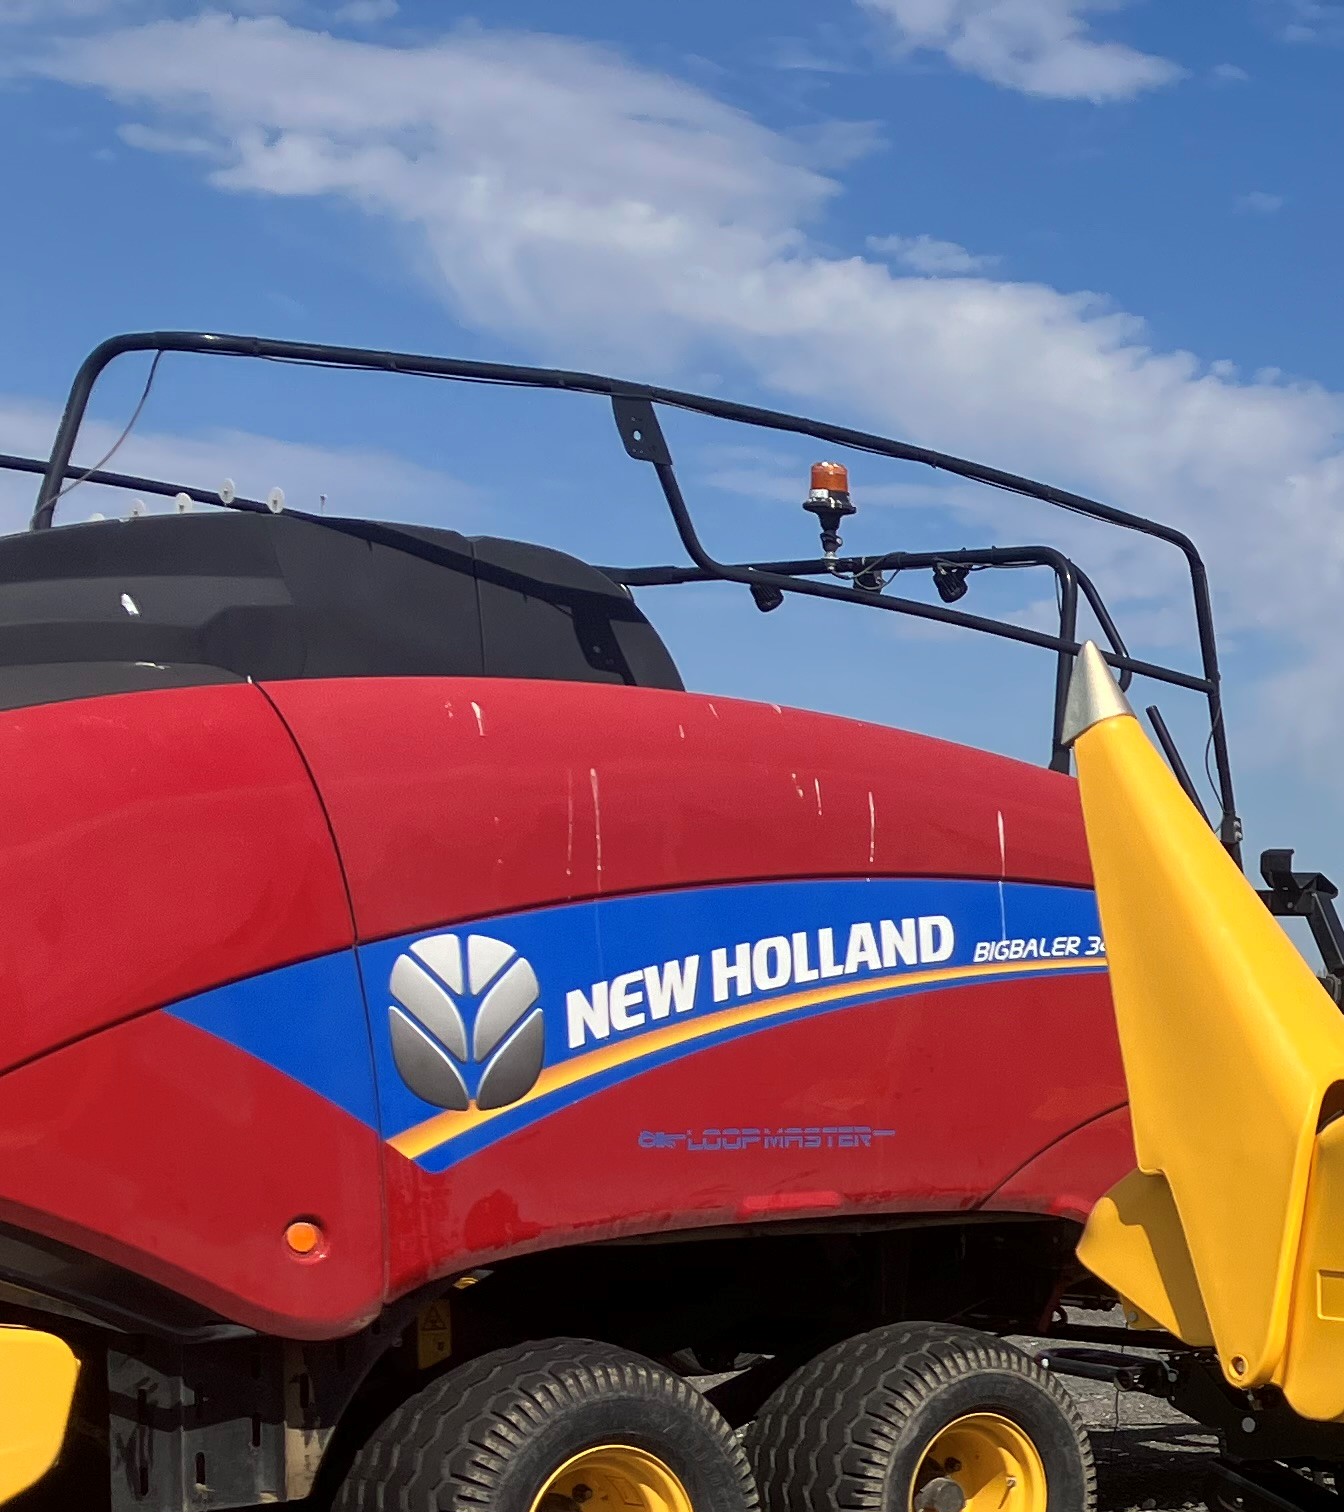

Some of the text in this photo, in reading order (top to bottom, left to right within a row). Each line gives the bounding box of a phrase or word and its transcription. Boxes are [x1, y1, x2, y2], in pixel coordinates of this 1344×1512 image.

[566, 915, 955, 1049] NEW HOLLAND
[973, 936, 1081, 962] BIGBALER
